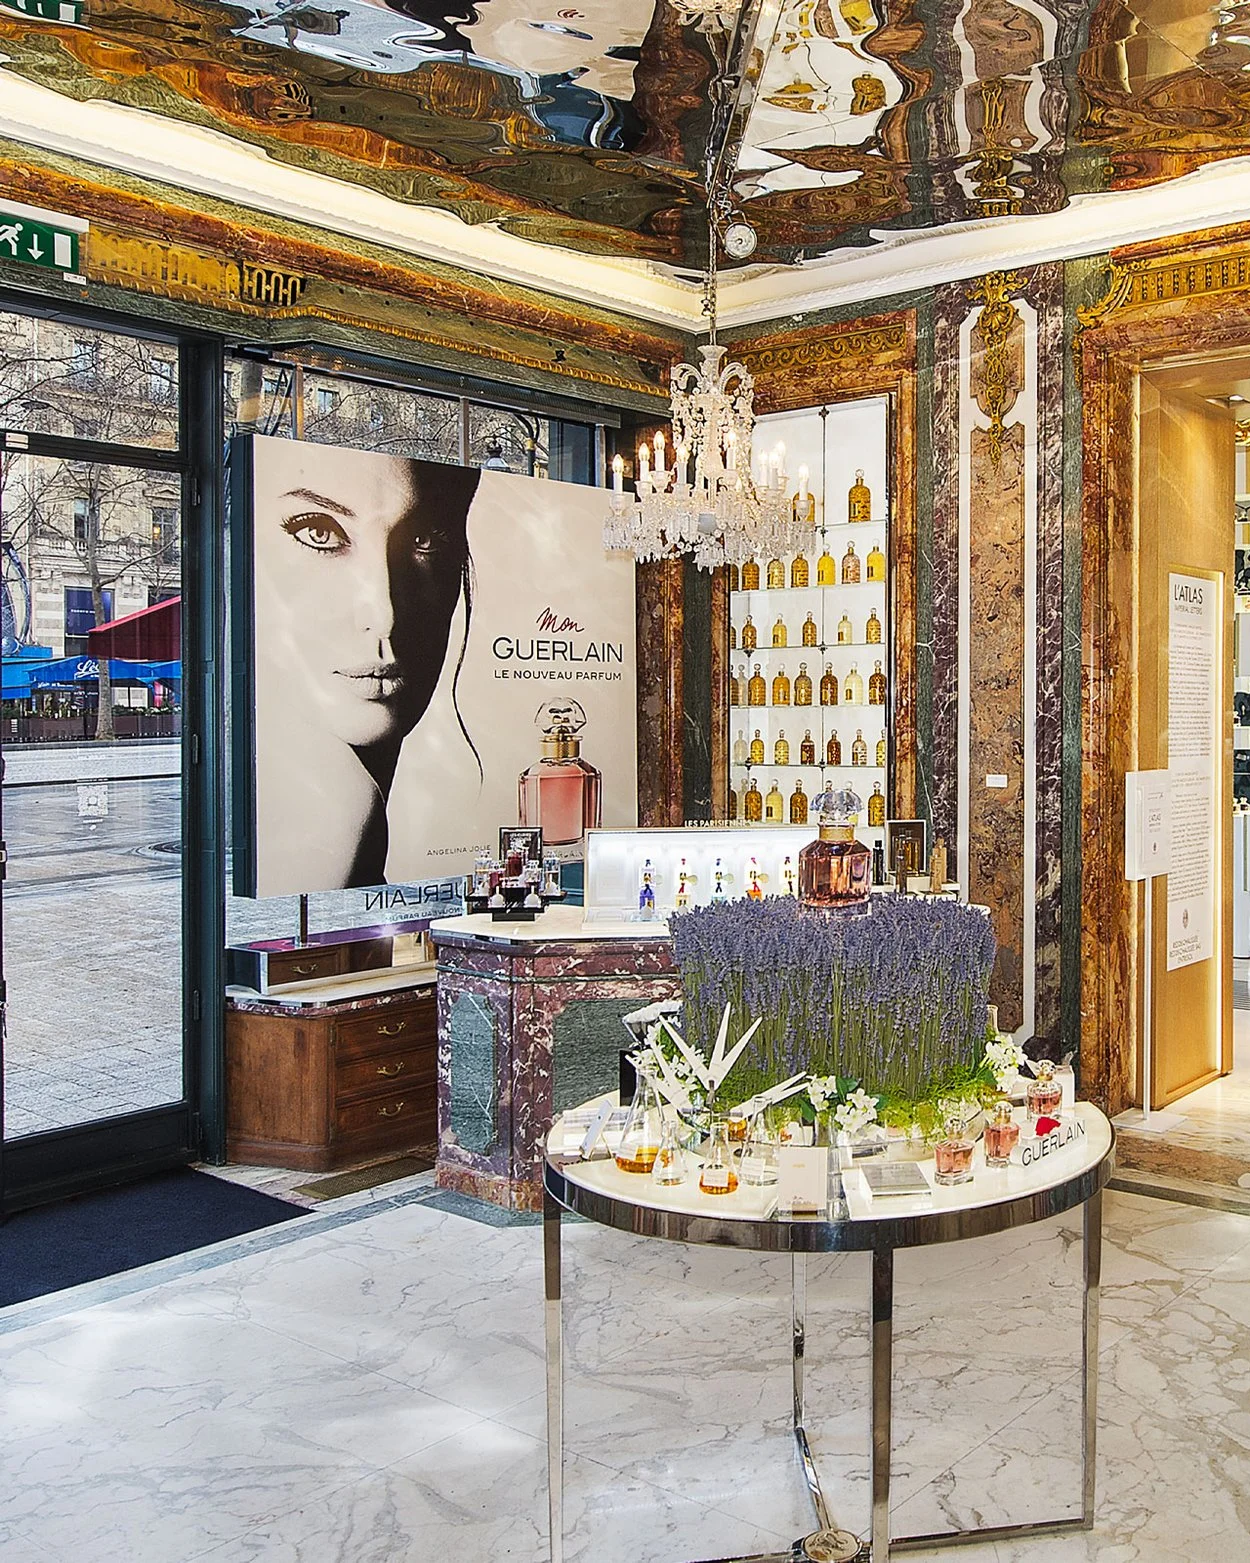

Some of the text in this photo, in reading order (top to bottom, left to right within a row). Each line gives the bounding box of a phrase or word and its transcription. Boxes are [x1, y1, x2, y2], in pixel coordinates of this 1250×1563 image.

[1174, 584, 1203, 605] L'ATLAS
[536, 607, 585, 633] Mon
[492, 636, 623, 663] GUERLAIN
[494, 669, 622, 681] LE NOUVEAU PARFUM
[684, 820, 698, 828] LES
[427, 844, 491, 856] ANGELINA JOLIE
[1022, 1119, 1085, 1166] GUERLAIN
